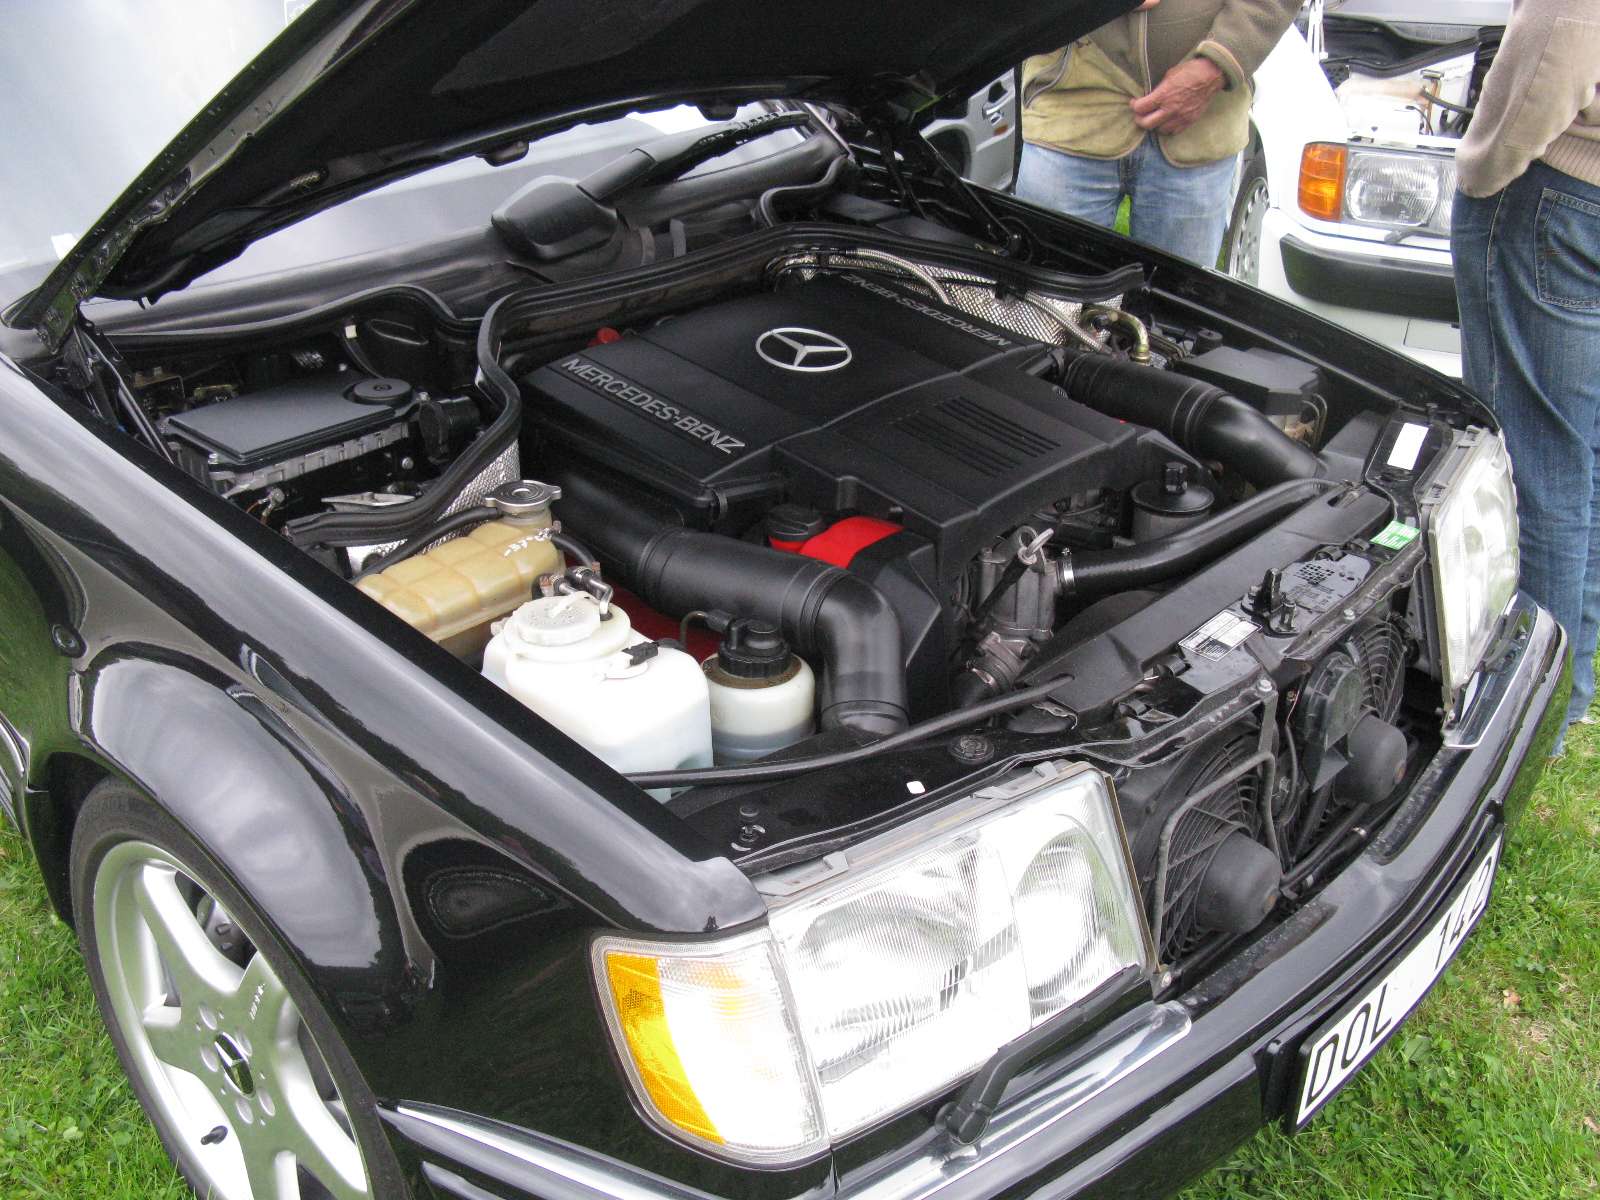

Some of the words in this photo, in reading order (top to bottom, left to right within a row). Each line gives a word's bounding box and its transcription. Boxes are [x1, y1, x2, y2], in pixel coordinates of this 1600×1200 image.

[561, 357, 746, 455] MERCEDES-BENZ
[1305, 982, 1393, 1110] DOL
[1433, 856, 1493, 971] 142
